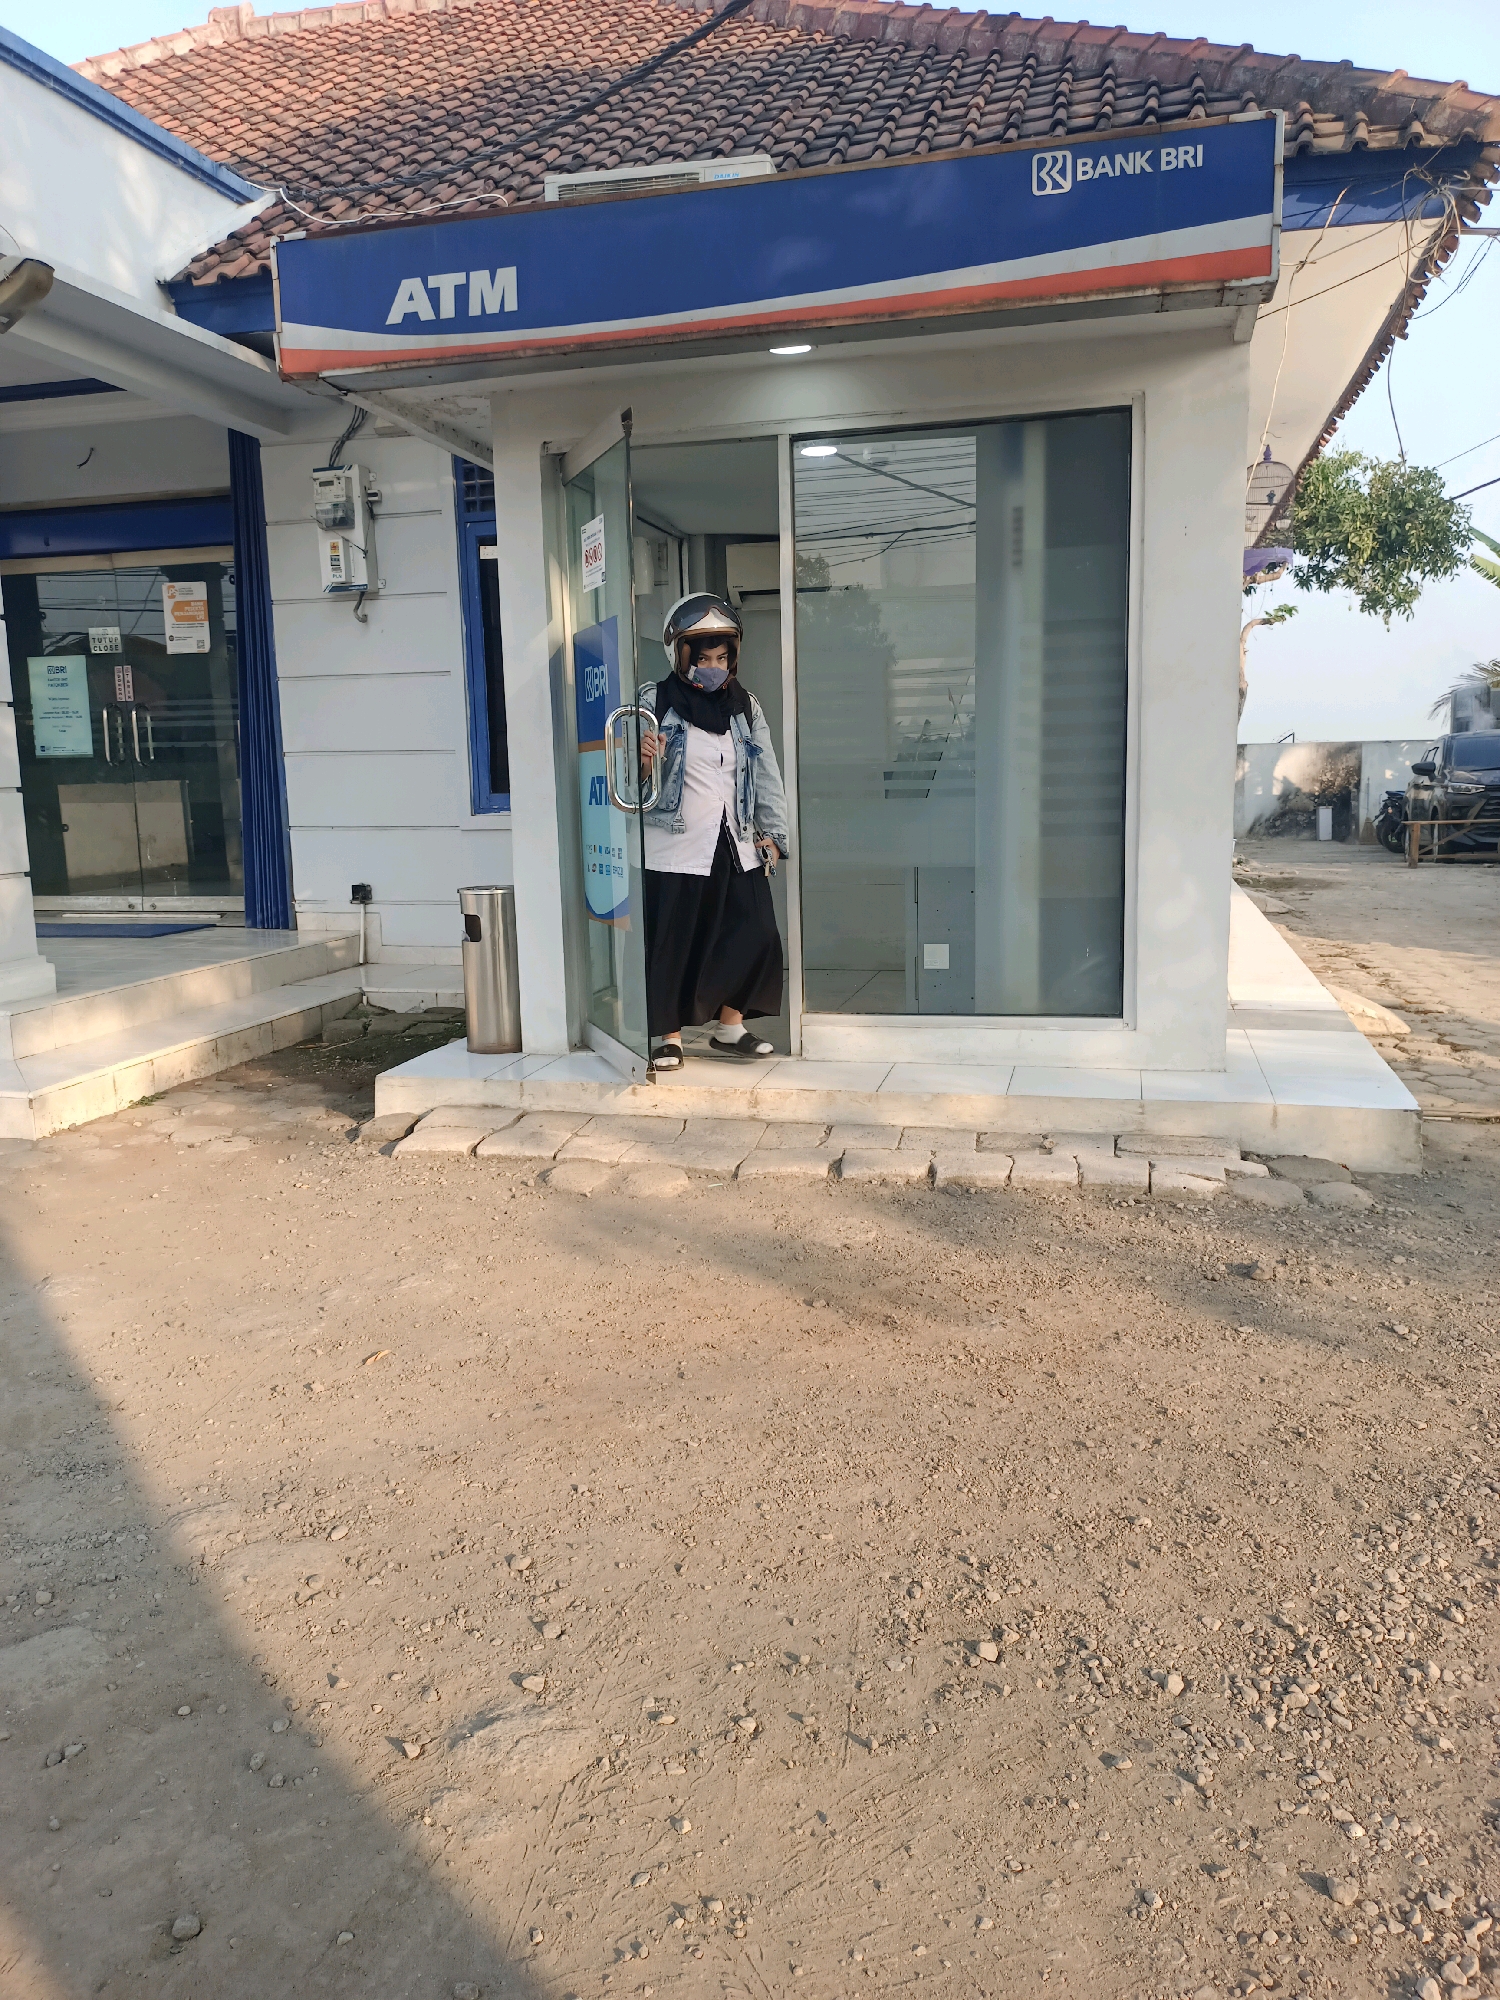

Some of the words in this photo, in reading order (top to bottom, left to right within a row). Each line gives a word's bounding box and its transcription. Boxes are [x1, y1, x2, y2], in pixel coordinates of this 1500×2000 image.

[1076, 150, 1153, 181] BANK
[1160, 144, 1203, 172] BRI
[385, 266, 518, 325] ATM
[91, 636, 119, 644] TUTUP
[93, 644, 119, 652] CLOSE
[55, 665, 67, 674] BRI
[593, 663, 609, 698] BRI
